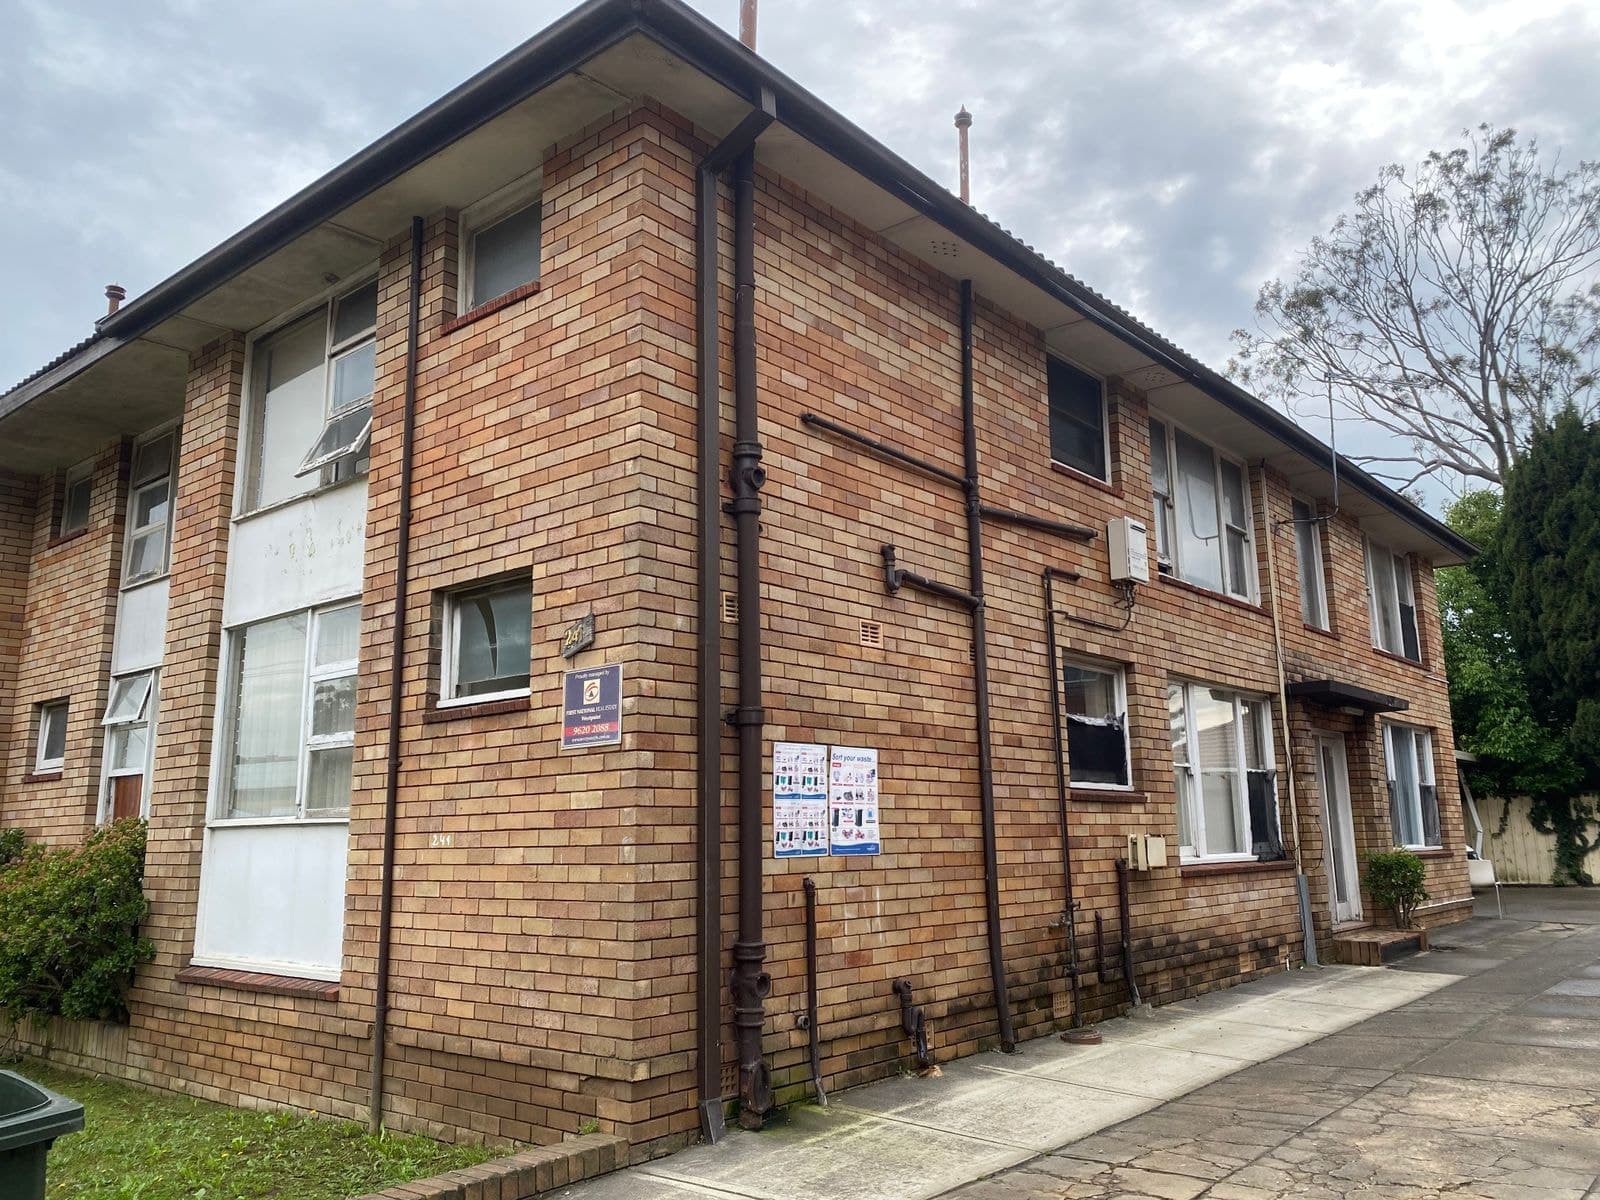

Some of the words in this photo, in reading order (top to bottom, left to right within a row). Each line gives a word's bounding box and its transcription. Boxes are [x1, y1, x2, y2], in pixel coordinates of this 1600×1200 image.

[577, 707, 596, 715] NATIONAL
[573, 724, 591, 736] 9620
[832, 752, 843, 761] Sort
[843, 755, 856, 763] your
